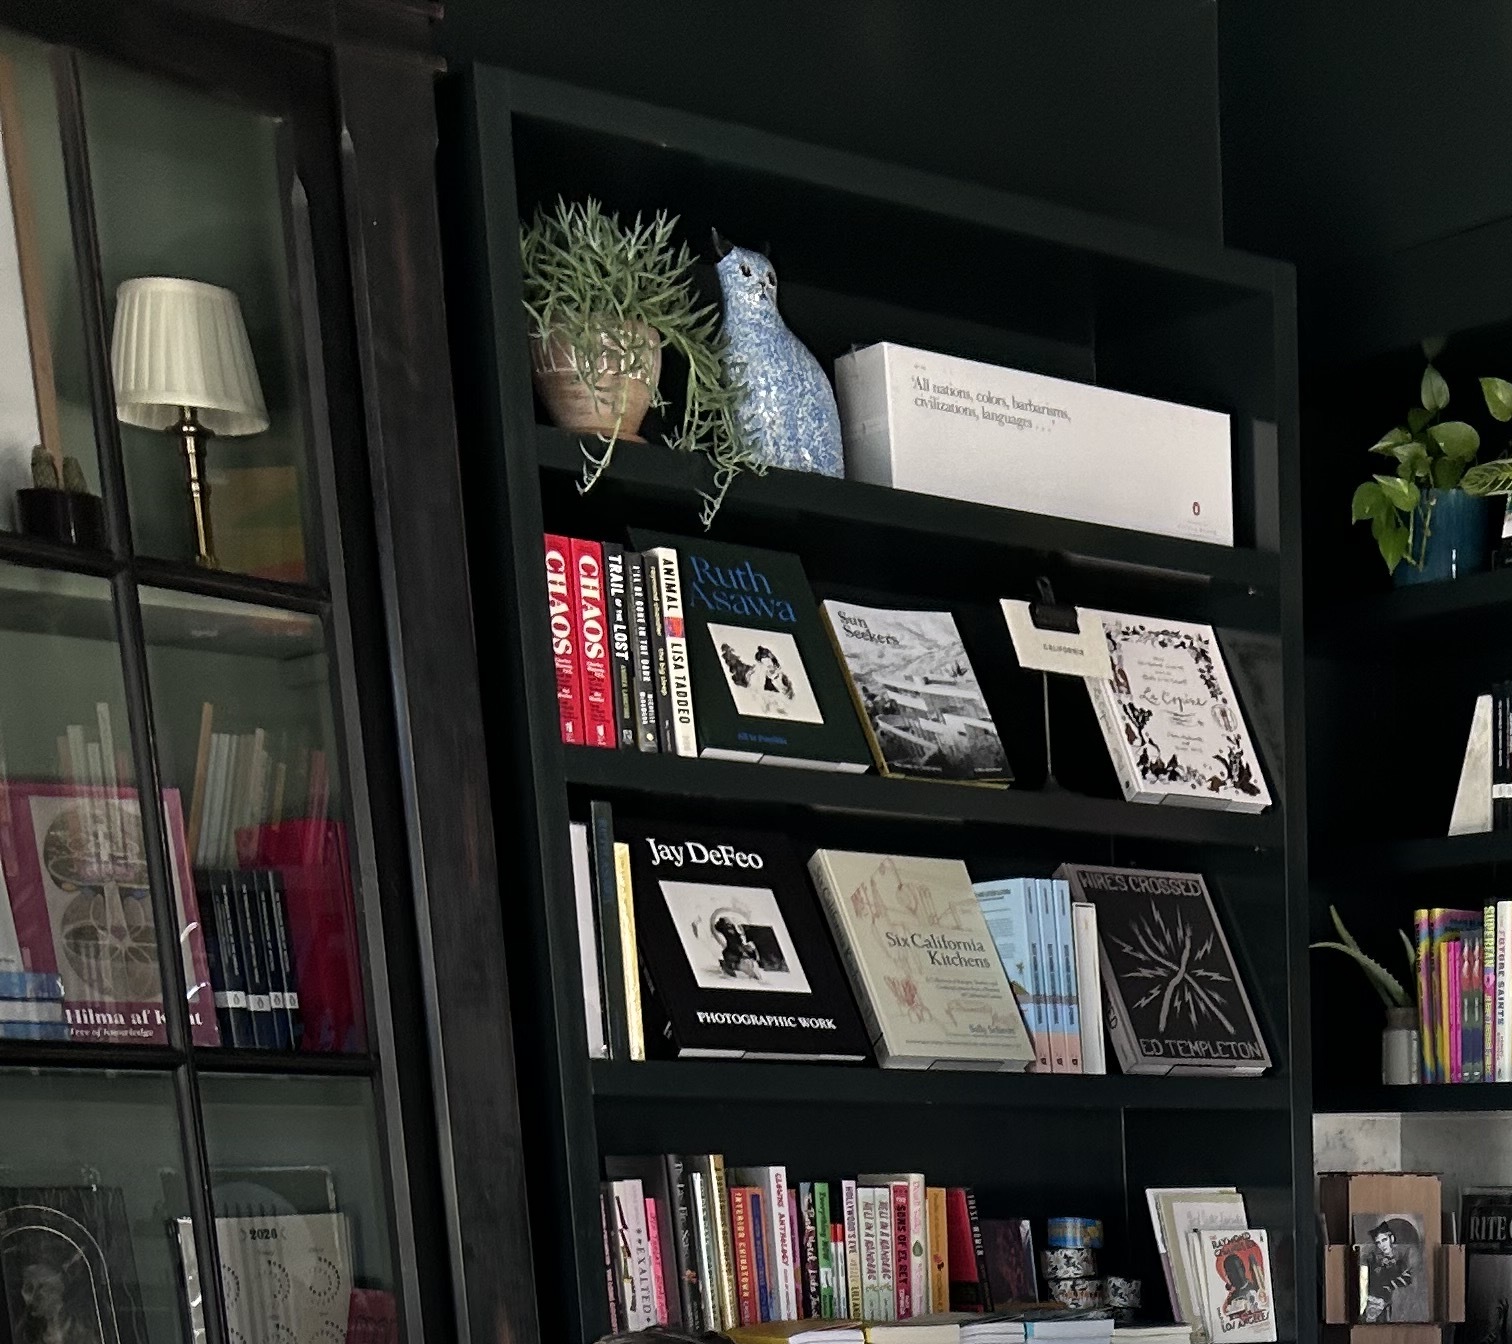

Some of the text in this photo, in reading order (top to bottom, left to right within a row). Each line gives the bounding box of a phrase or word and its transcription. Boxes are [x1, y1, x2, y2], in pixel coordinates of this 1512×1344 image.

[662, 558, 678, 612] ANIMAL
[690, 555, 772, 595] Ruth
[545, 550, 573, 656] CHAOS
[578, 554, 606, 660] CHAOS
[690, 581, 797, 623] Asawa
[838, 611, 868, 629] Sun
[843, 624, 901, 648] Seekers
[671, 643, 691, 724] LISA TADDEO
[646, 838, 764, 869] Jay DeFeo
[1080, 874, 1202, 897] WIRES CROSSED
[885, 931, 986, 953] Six California
[928, 950, 991, 969] Kitchens
[696, 1011, 837, 1030] PHOTOGRAPHIC WORK
[1142, 1038, 1262, 1060] ED TEMPLETON
[1470, 1215, 1507, 1242] RITE
[636, 1246, 652, 1314] EXALTED
